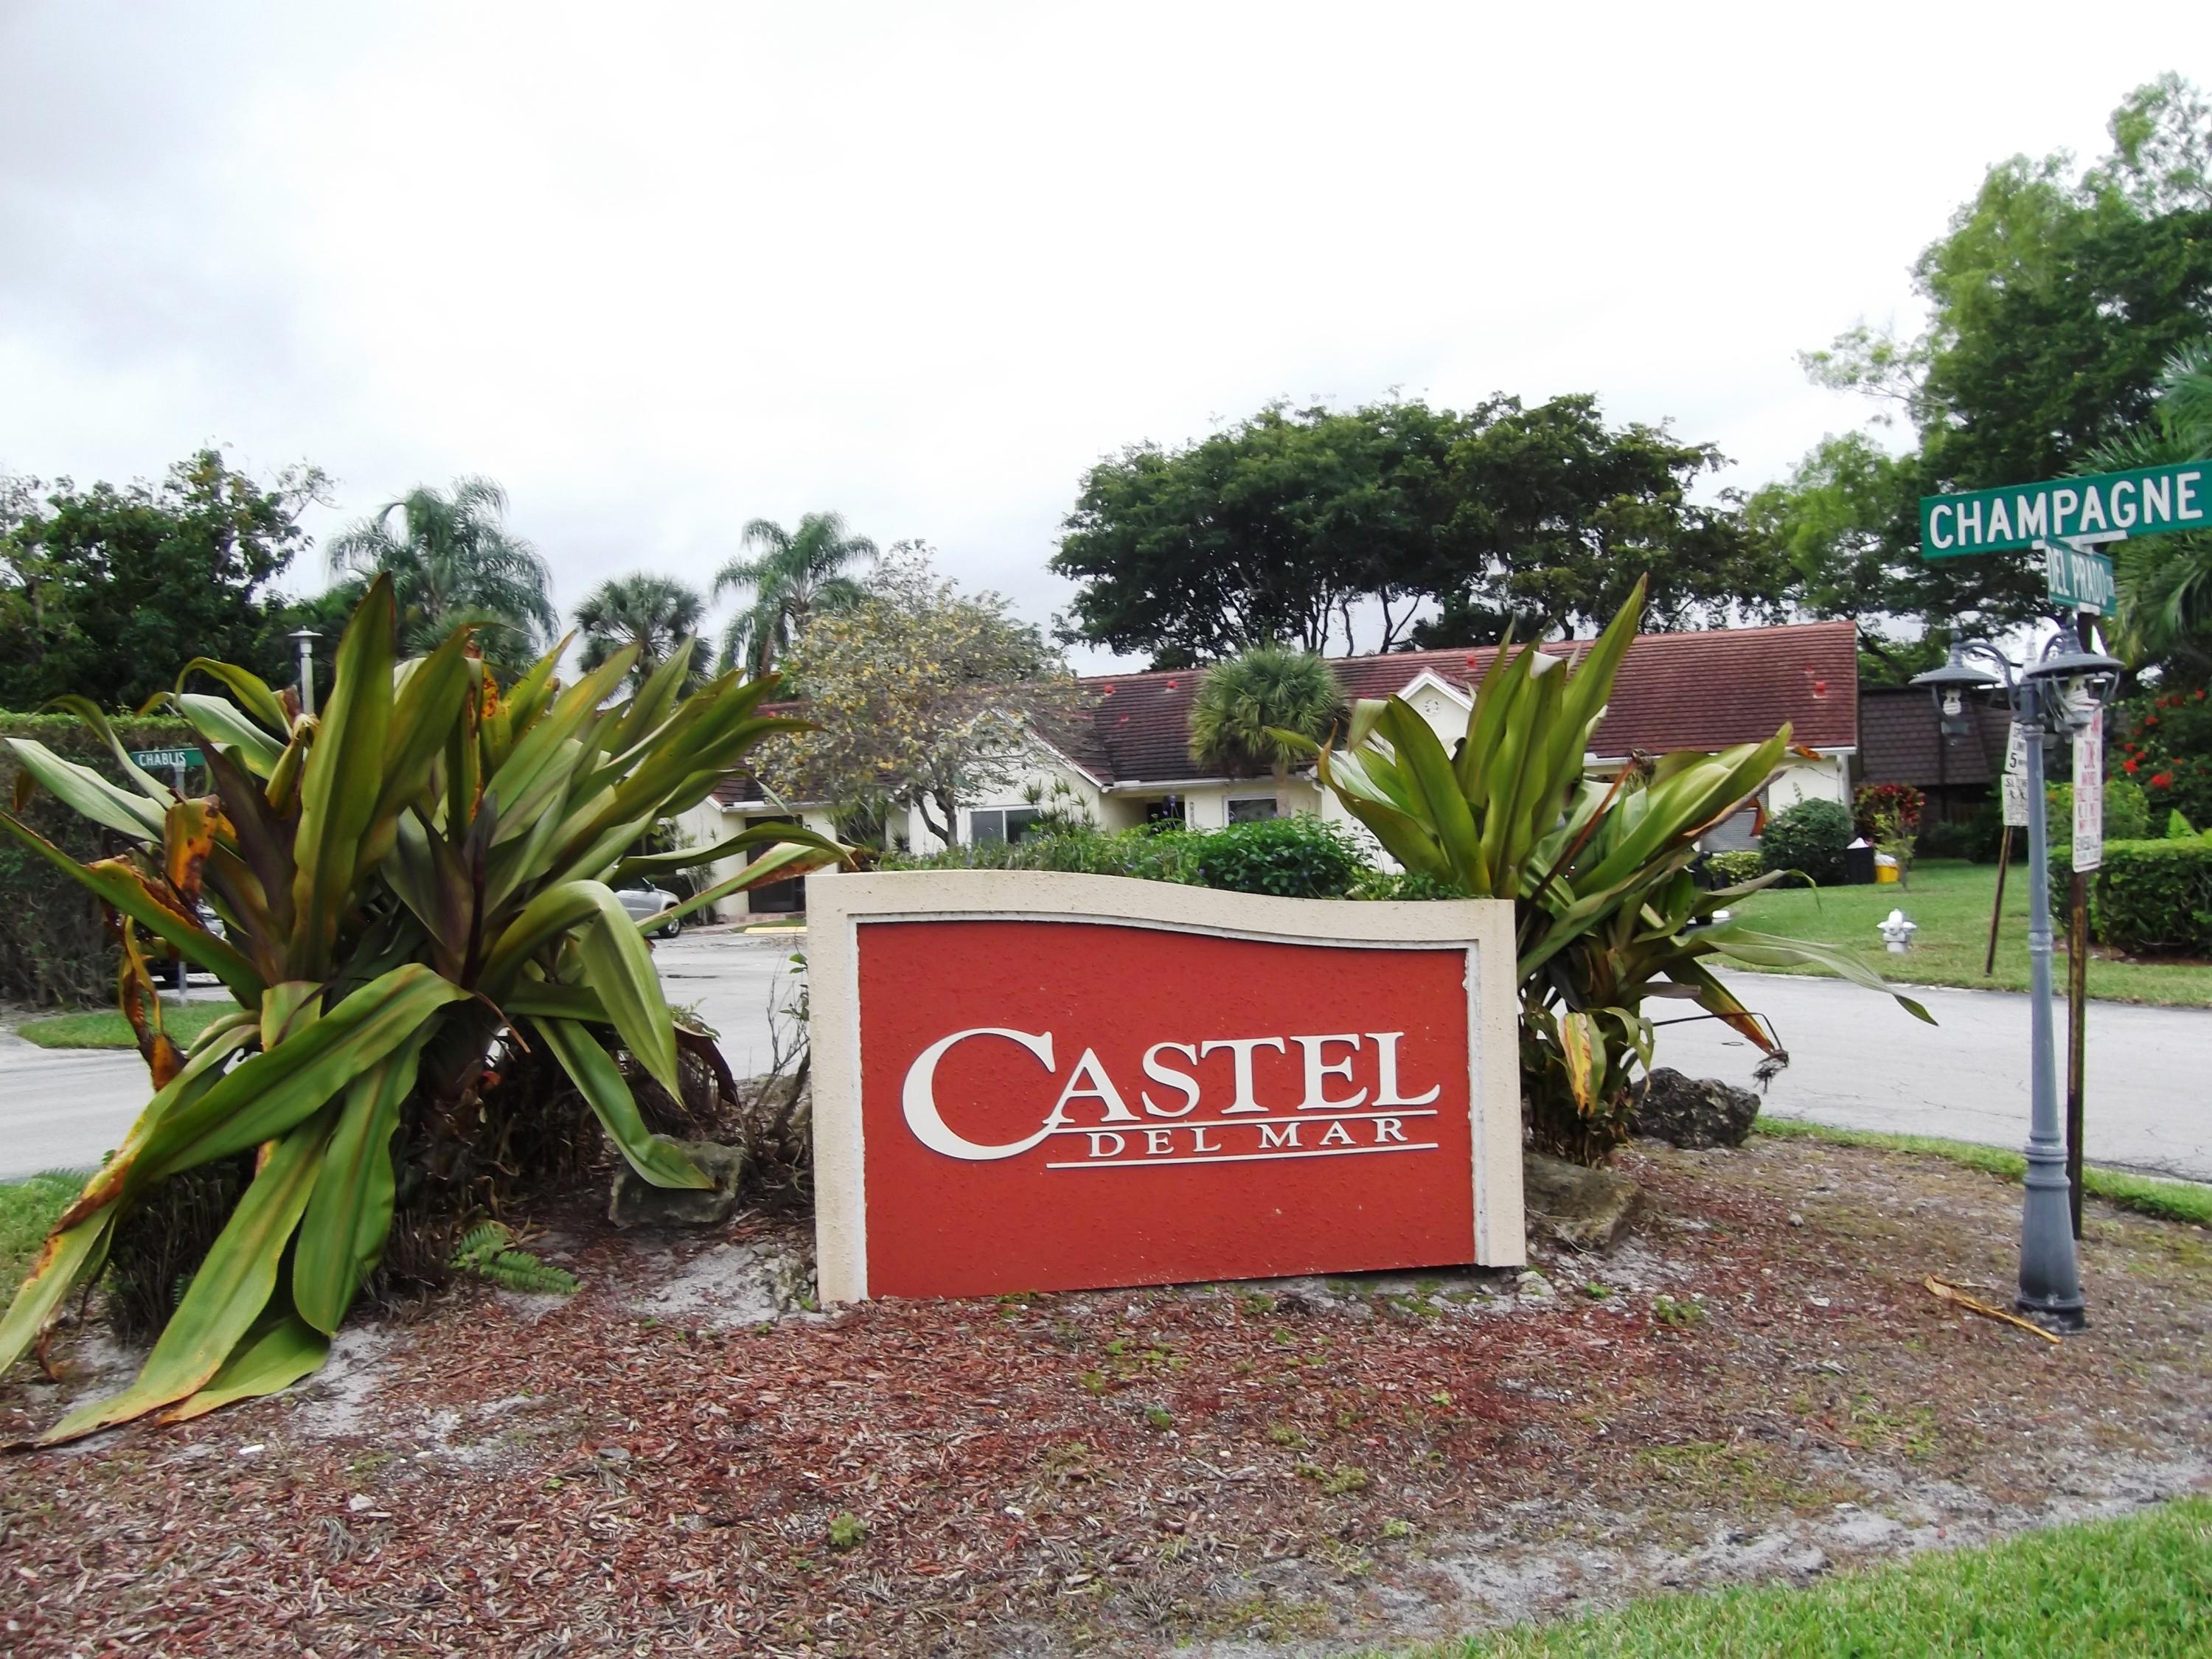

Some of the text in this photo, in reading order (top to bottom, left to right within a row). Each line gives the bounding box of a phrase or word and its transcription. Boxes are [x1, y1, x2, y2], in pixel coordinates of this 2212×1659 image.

[1930, 471, 2203, 549] CHAMPAGNE
[2045, 545, 2070, 597] DEL
[2070, 554, 2107, 606] PRADO
[139, 751, 187, 767] CHABLIS
[902, 1027, 1441, 1161] CASTEL
[1088, 1119, 1408, 1158] DEL MAR
